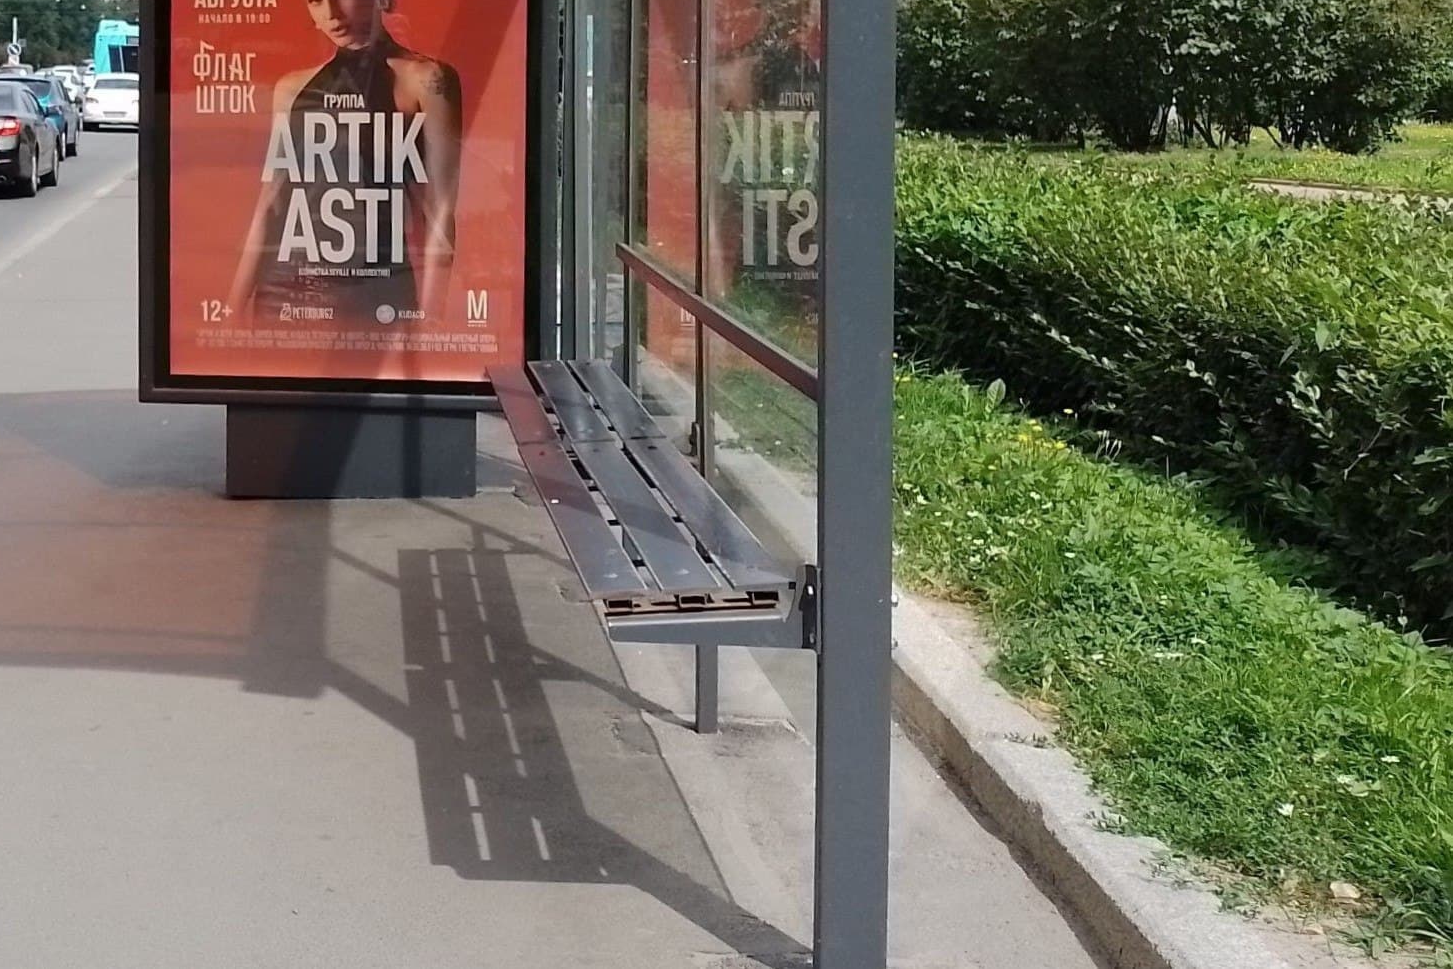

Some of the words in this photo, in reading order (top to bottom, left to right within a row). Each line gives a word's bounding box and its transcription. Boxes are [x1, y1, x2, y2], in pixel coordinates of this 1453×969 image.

[198, 13, 234, 24] НАЧАЛО
[236, 13, 242, 24] В
[193, 40, 256, 82] ФЛАГ
[196, 85, 256, 114] ШТОК
[323, 94, 365, 109] ГРУППА
[261, 112, 428, 184] ARTIK
[277, 188, 404, 264] ASTI
[200, 299, 234, 322] 12+
